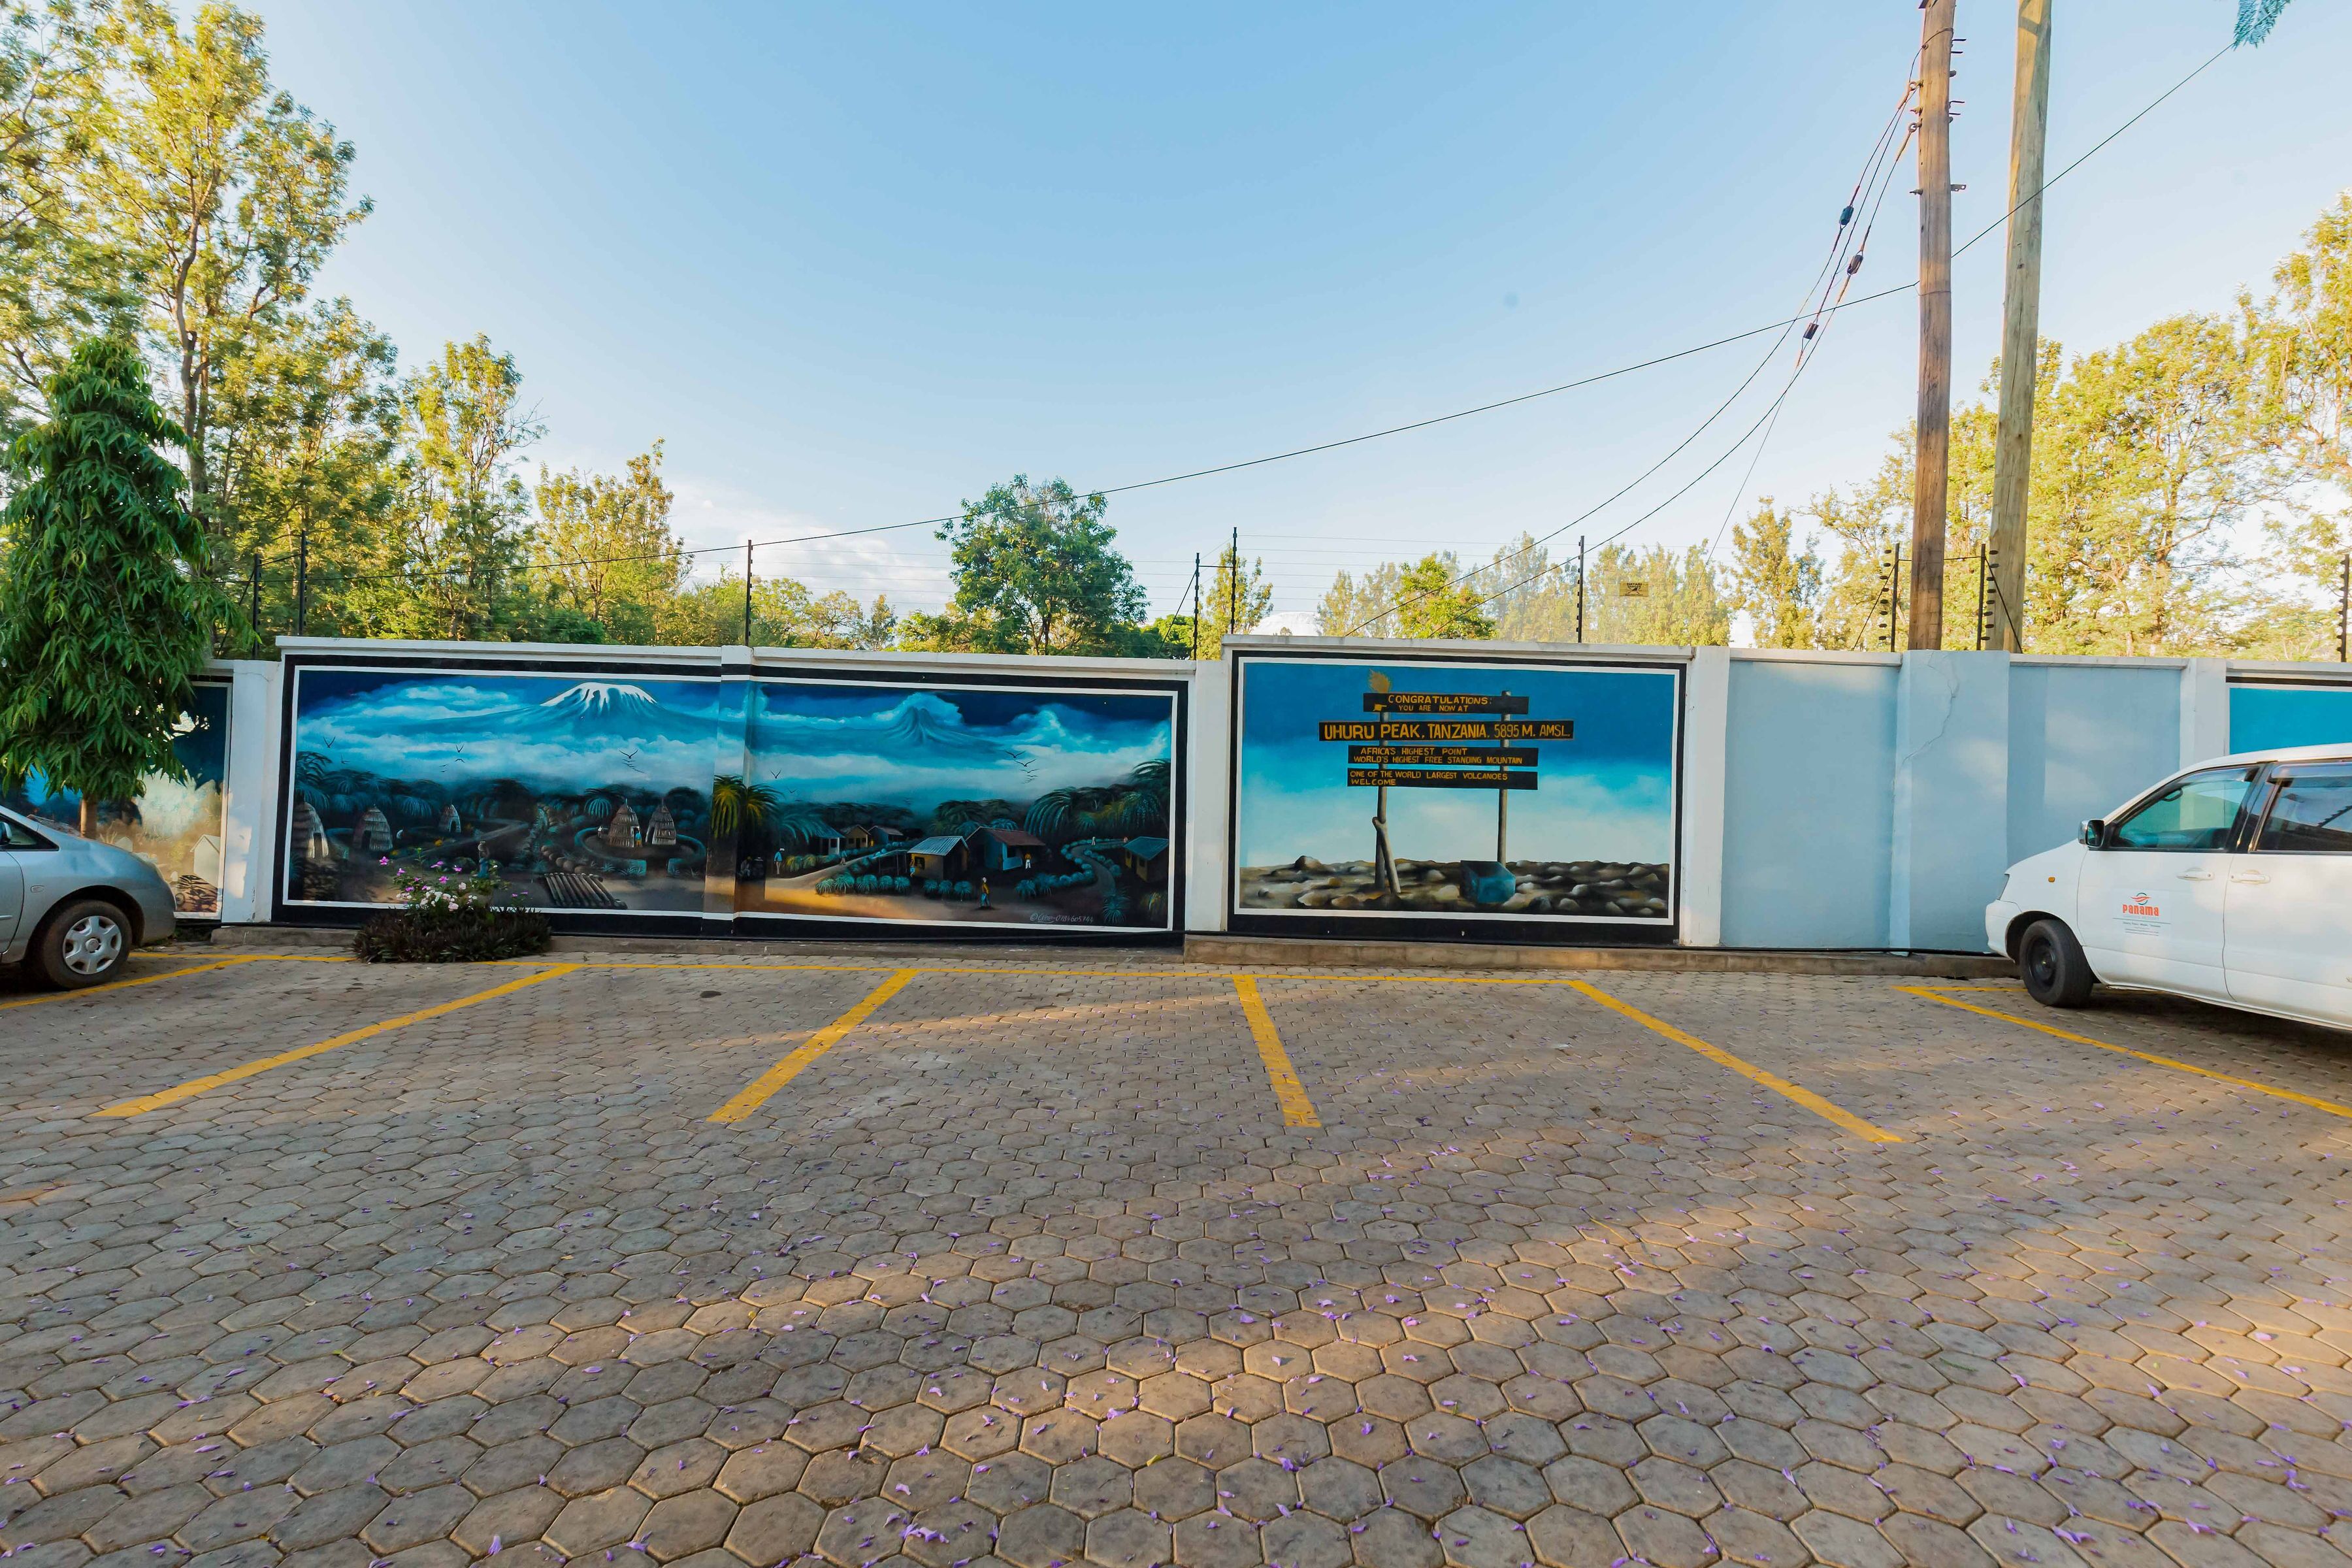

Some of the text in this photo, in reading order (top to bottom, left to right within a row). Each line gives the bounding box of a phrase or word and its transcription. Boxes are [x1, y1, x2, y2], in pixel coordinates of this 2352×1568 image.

[1324, 723, 1375, 740] UHURU
[1494, 723, 1519, 738] 5895
[1522, 724, 1536, 738] M.
[1360, 747, 1397, 755] AFRICA'S
[1447, 756, 1482, 764] STANDING
[1486, 756, 1523, 764] MOUNTAIN
[1463, 772, 1508, 781] VOLCANOES
